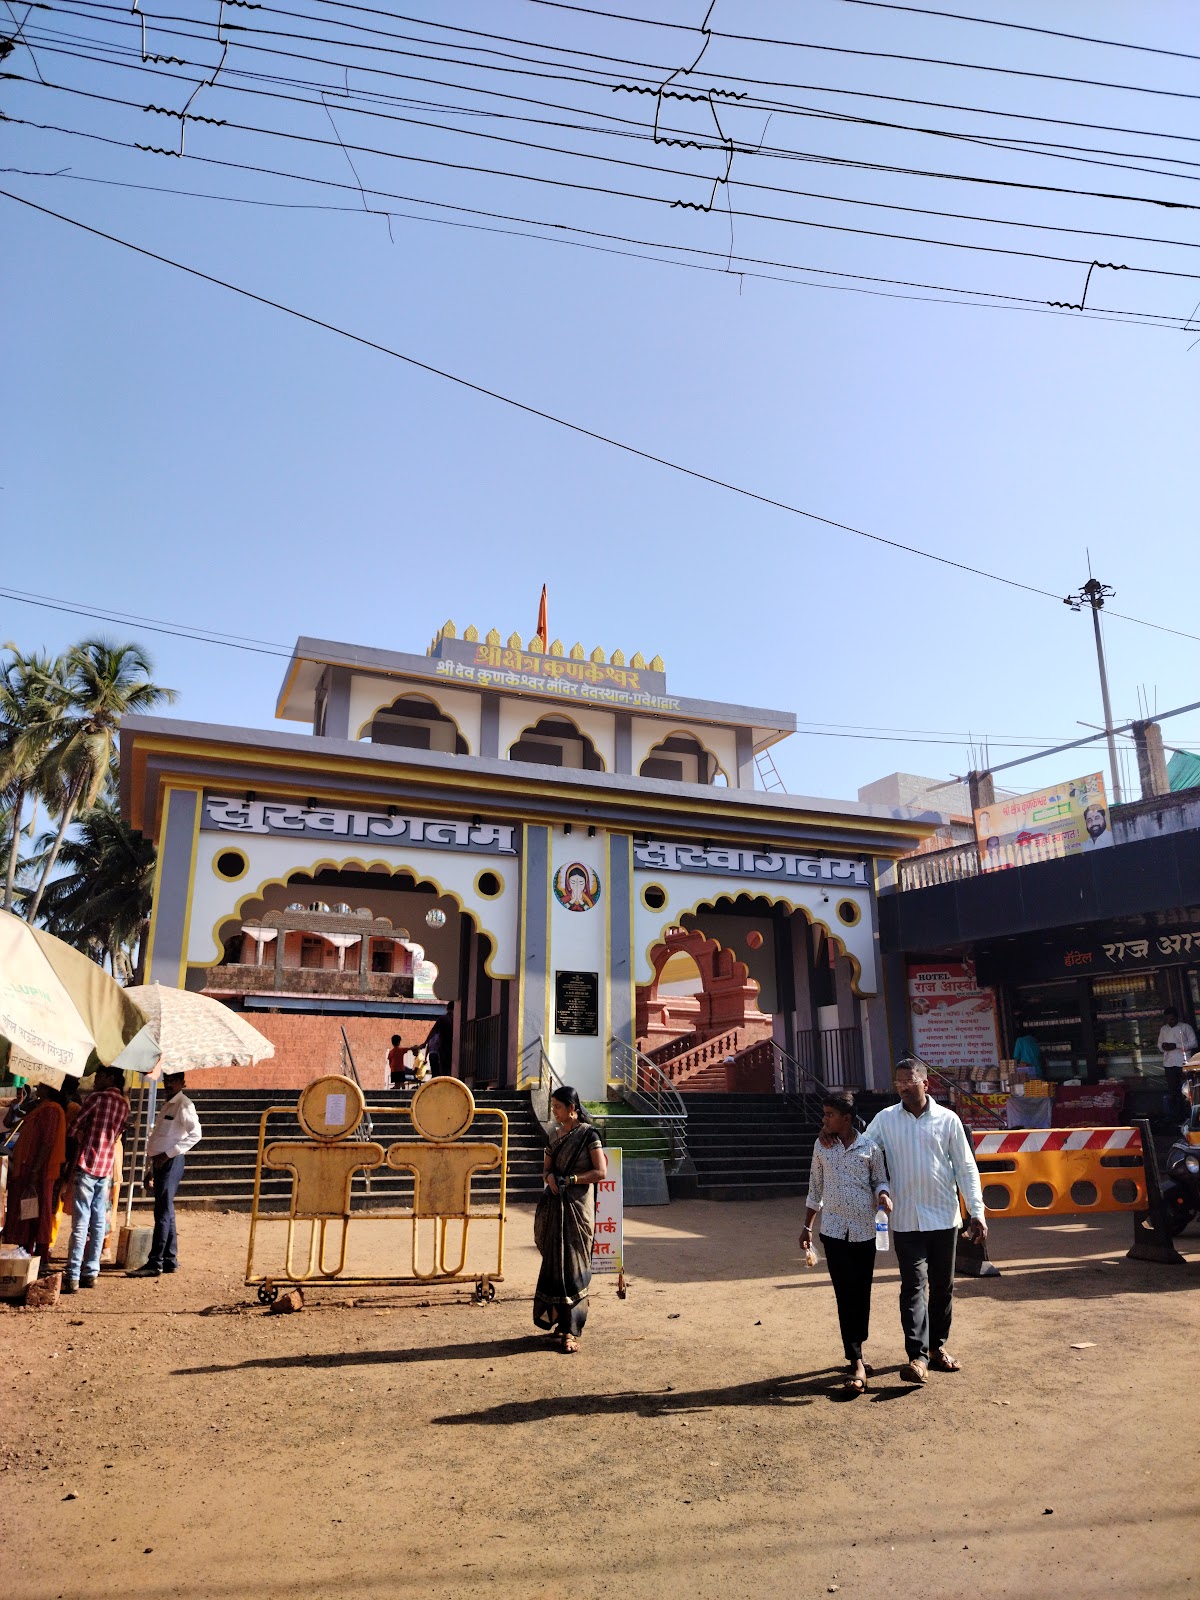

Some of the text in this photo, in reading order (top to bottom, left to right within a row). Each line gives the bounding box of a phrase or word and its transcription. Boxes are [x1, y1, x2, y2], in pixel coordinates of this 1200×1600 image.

[436, 660, 455, 676] श्री
[456, 662, 474, 681] देव
[477, 667, 546, 691] कुणकेश्वर
[547, 676, 578, 697] मंदिर
[542, 659, 641, 689] कुणकेश्वर
[1064, 950, 1092, 967] हॉटेल
[1102, 939, 1148, 963] राज
[915, 980, 978, 993] राज आस्वा
[596, 1180, 616, 1193] ारा
